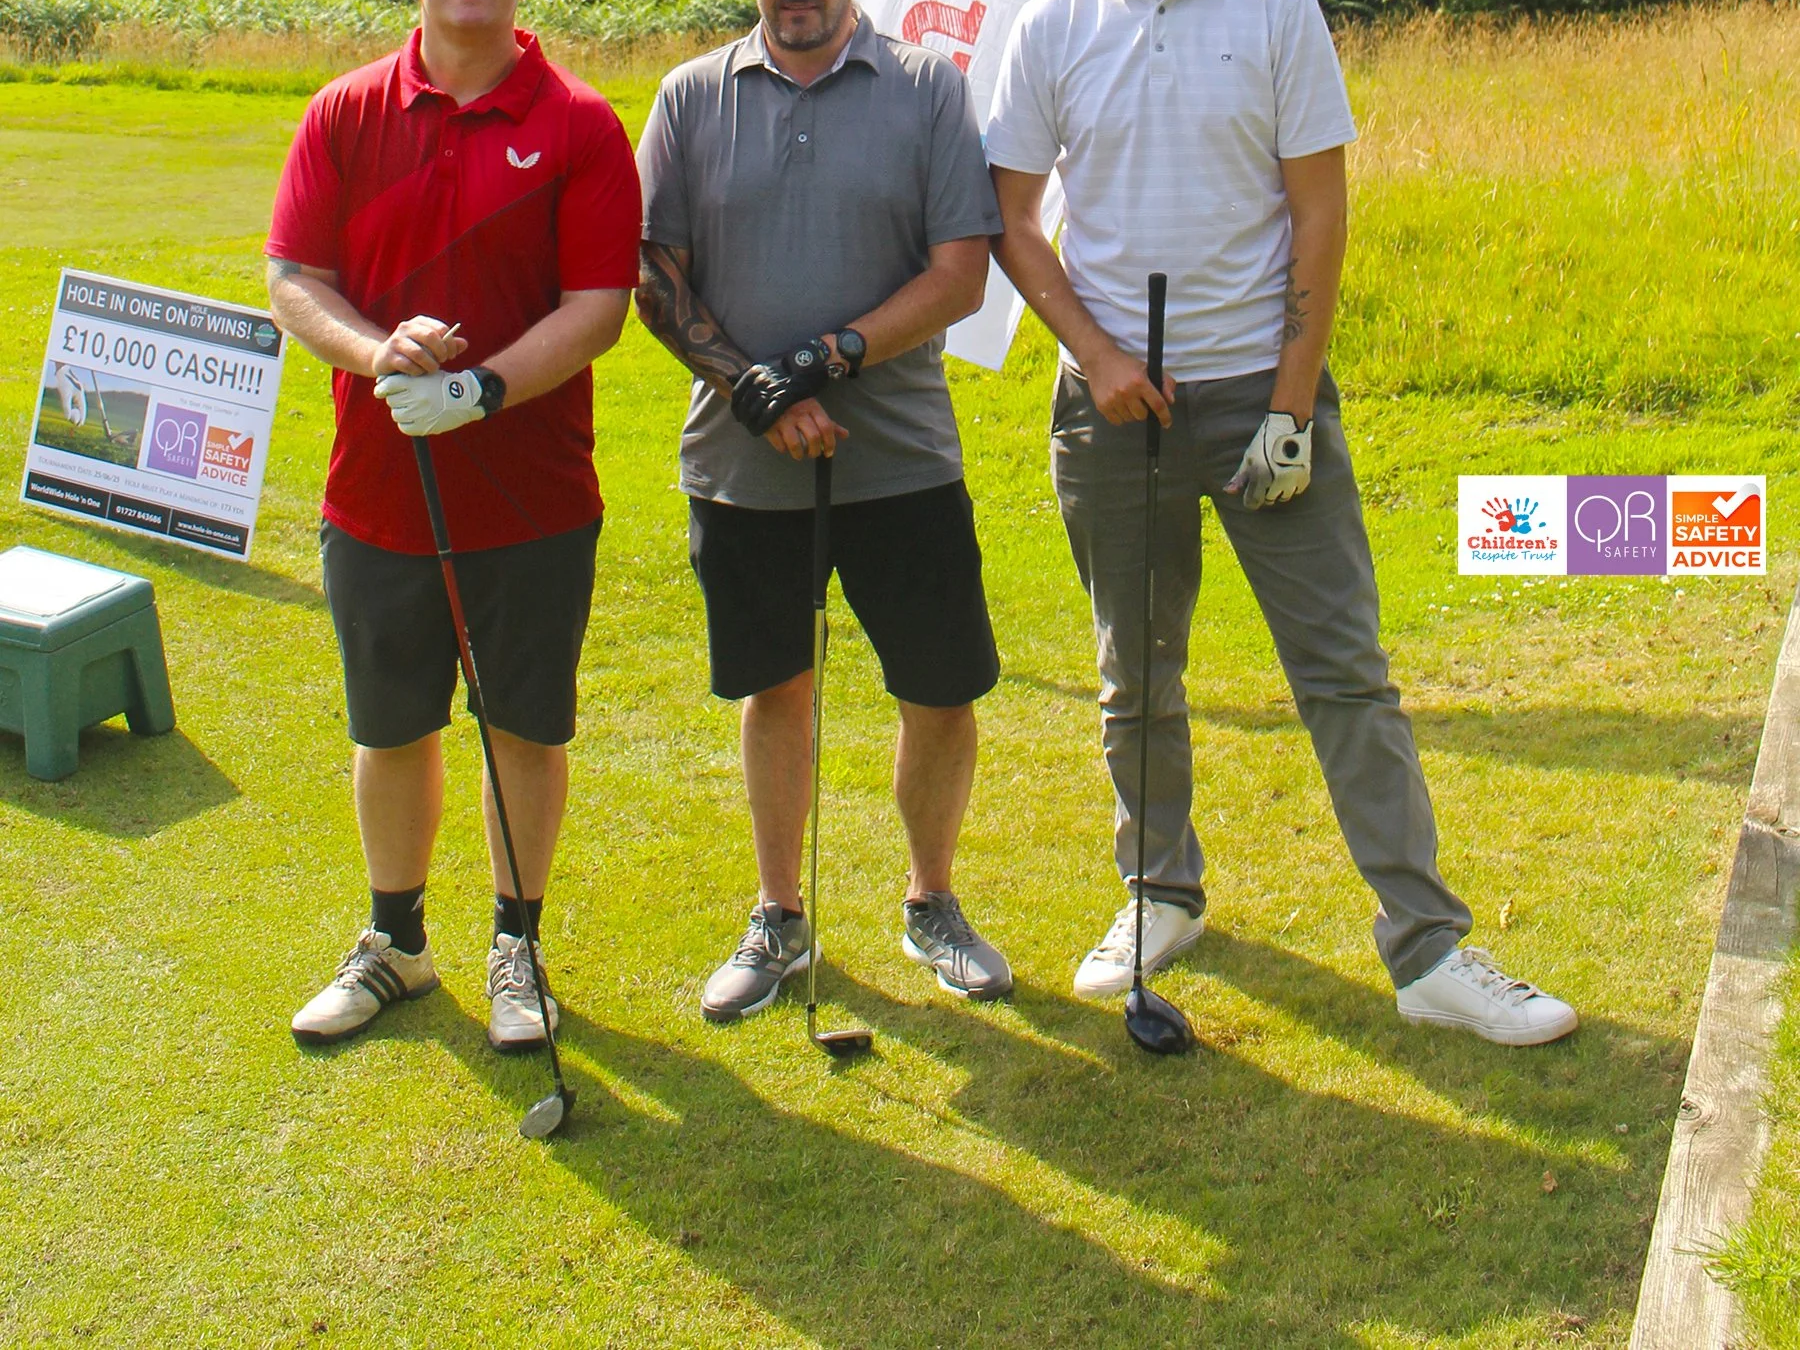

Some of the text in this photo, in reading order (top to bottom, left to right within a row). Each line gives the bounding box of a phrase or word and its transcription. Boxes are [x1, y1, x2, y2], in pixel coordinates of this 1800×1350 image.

[66, 284, 106, 308] HOLE
[109, 294, 125, 311] IN
[129, 298, 161, 320] ONE
[165, 306, 187, 326] ON
[207, 314, 252, 339] WINS!
[190, 305, 207, 314] HOLE
[190, 315, 203, 328] 07
[63, 325, 263, 394] £10,000 CASH!!!
[155, 418, 200, 458] QR
[206, 441, 230, 452] SIMPLE
[167, 453, 194, 467] SAFETY
[205, 449, 249, 470] SAFETY
[201, 465, 247, 487] ADVICE
[86, 496, 101, 508] One
[115, 504, 136, 518] 01727
